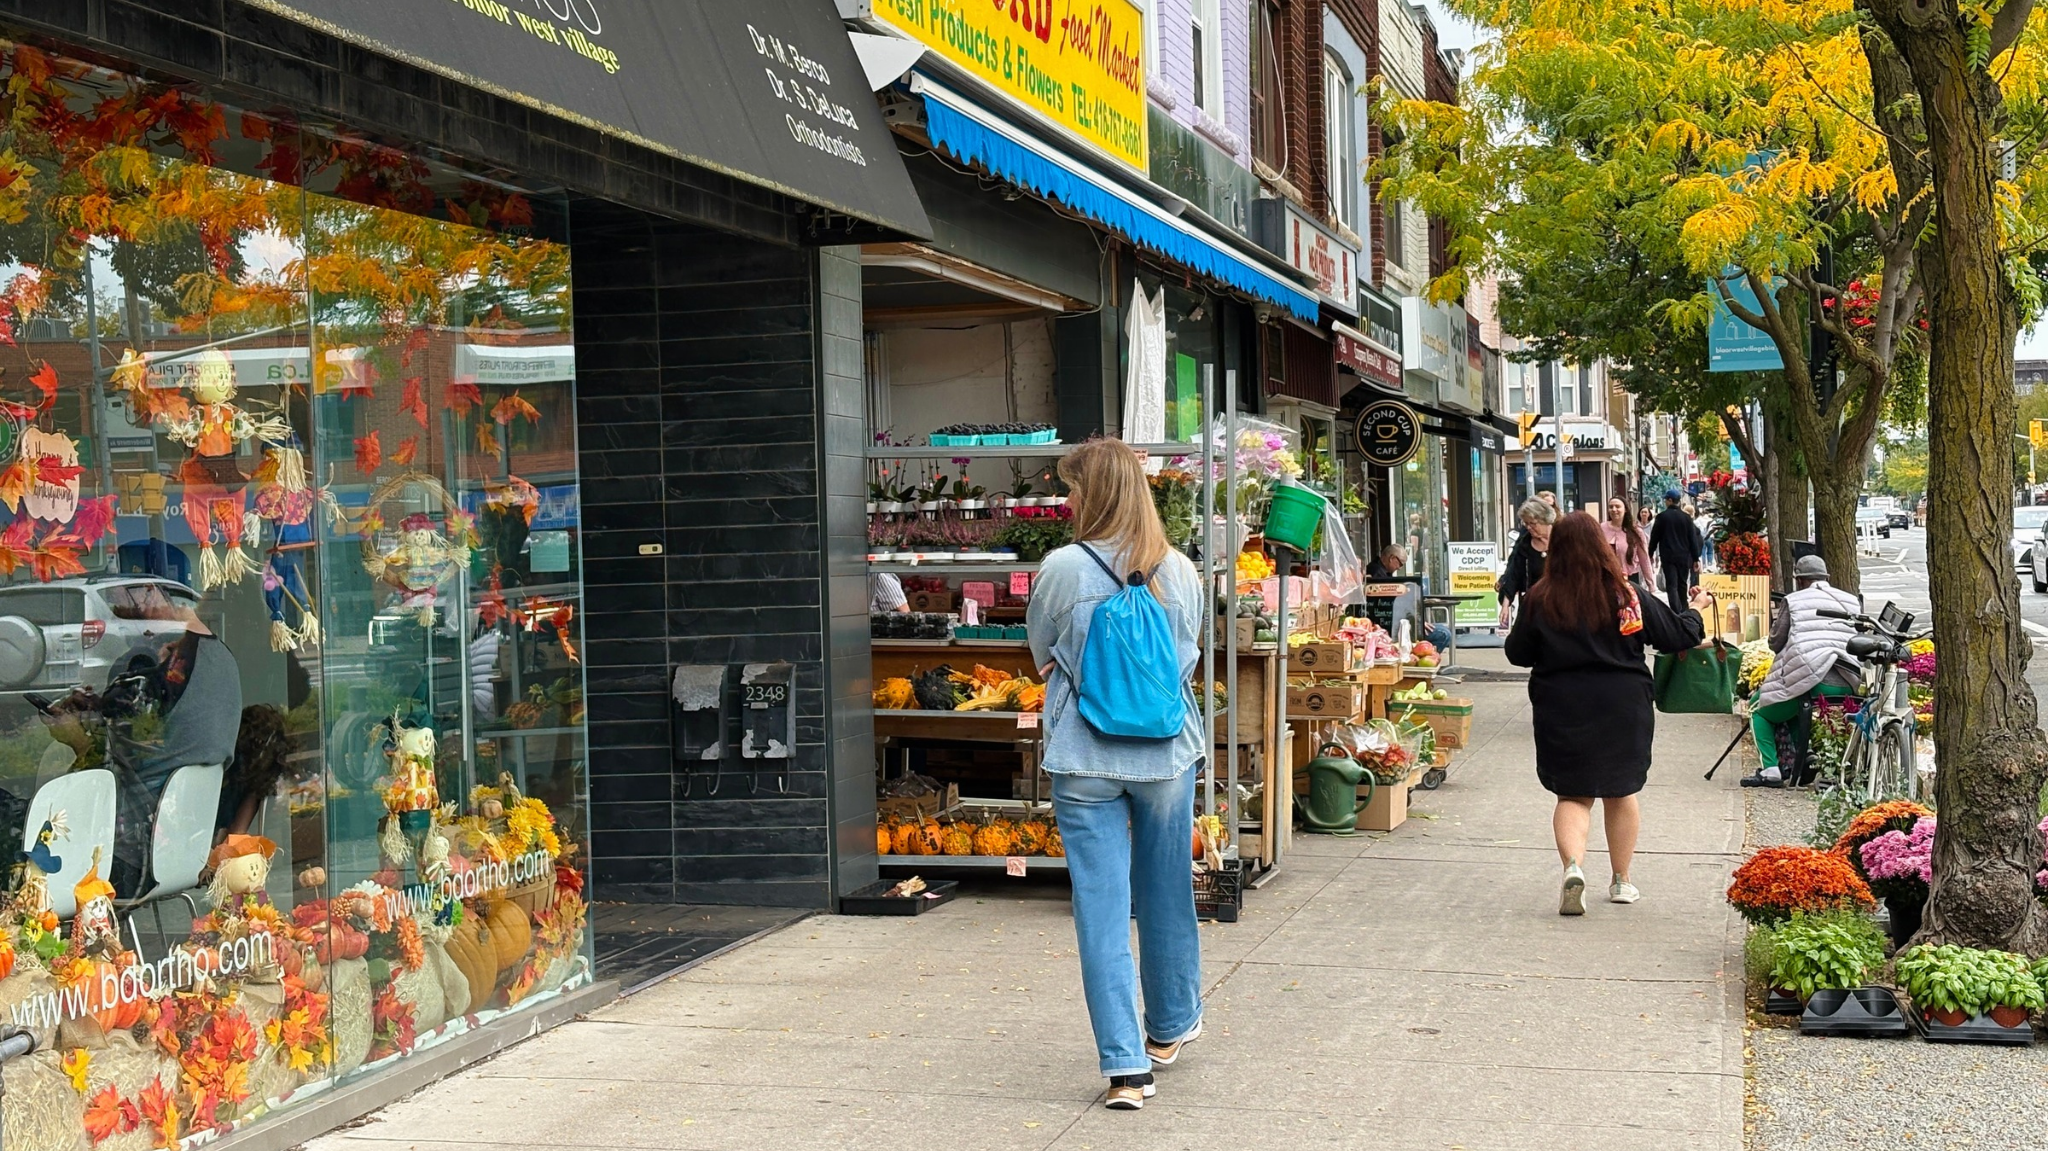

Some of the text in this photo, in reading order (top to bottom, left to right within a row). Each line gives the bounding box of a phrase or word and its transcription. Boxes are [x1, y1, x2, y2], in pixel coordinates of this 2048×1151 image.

[513, 10, 561, 46] west
[559, 27, 621, 75] village
[747, 23, 831, 86] Dr. M. Berco
[930, 0, 998, 73] Products
[1003, 36, 1012, 81] &
[1017, 44, 1064, 114] Flowers
[1095, 4, 1140, 96] Market
[765, 67, 860, 131] Dr. S. DeLuca
[785, 113, 867, 167] Orthodontists
[1363, 405, 1411, 436] SECOND CUP
[1376, 445, 1398, 455] CAFÉ
[1452, 547, 1494, 556] We Accept
[1461, 557, 1485, 565] CDCP
[1712, 592, 1756, 600] PUMPKIN
[745, 686, 785, 701] 2348
[384, 848, 551, 920] www.bdortho.com
[10, 930, 273, 1029] www.bdortho.com
